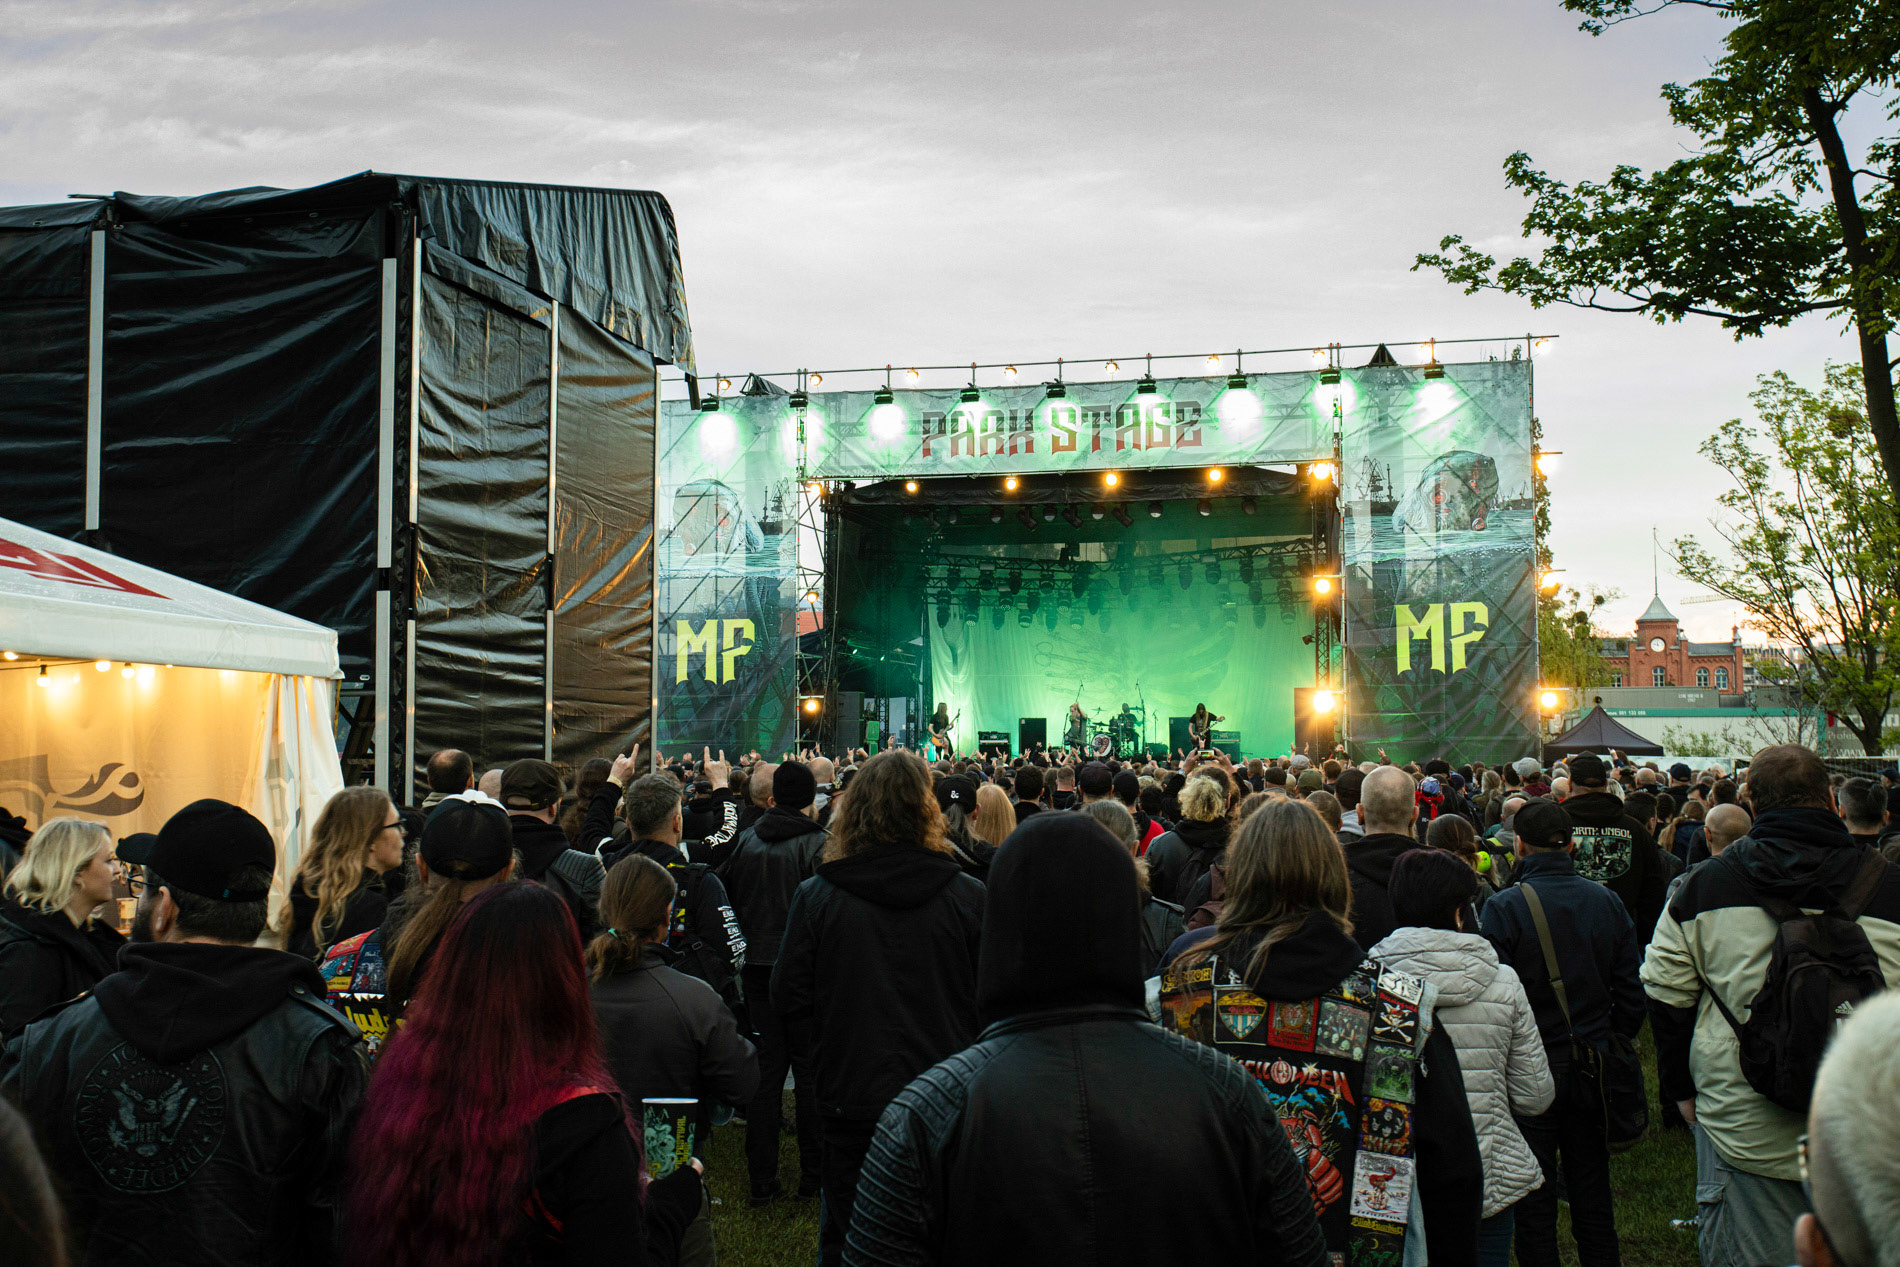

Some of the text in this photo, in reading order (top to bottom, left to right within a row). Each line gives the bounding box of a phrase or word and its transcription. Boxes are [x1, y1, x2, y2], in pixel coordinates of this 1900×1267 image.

[922, 401, 1203, 458] PARK STAGE
[676, 619, 755, 685] MP
[1394, 602, 1488, 675] MP
[1600, 827, 1632, 839] UNGOL
